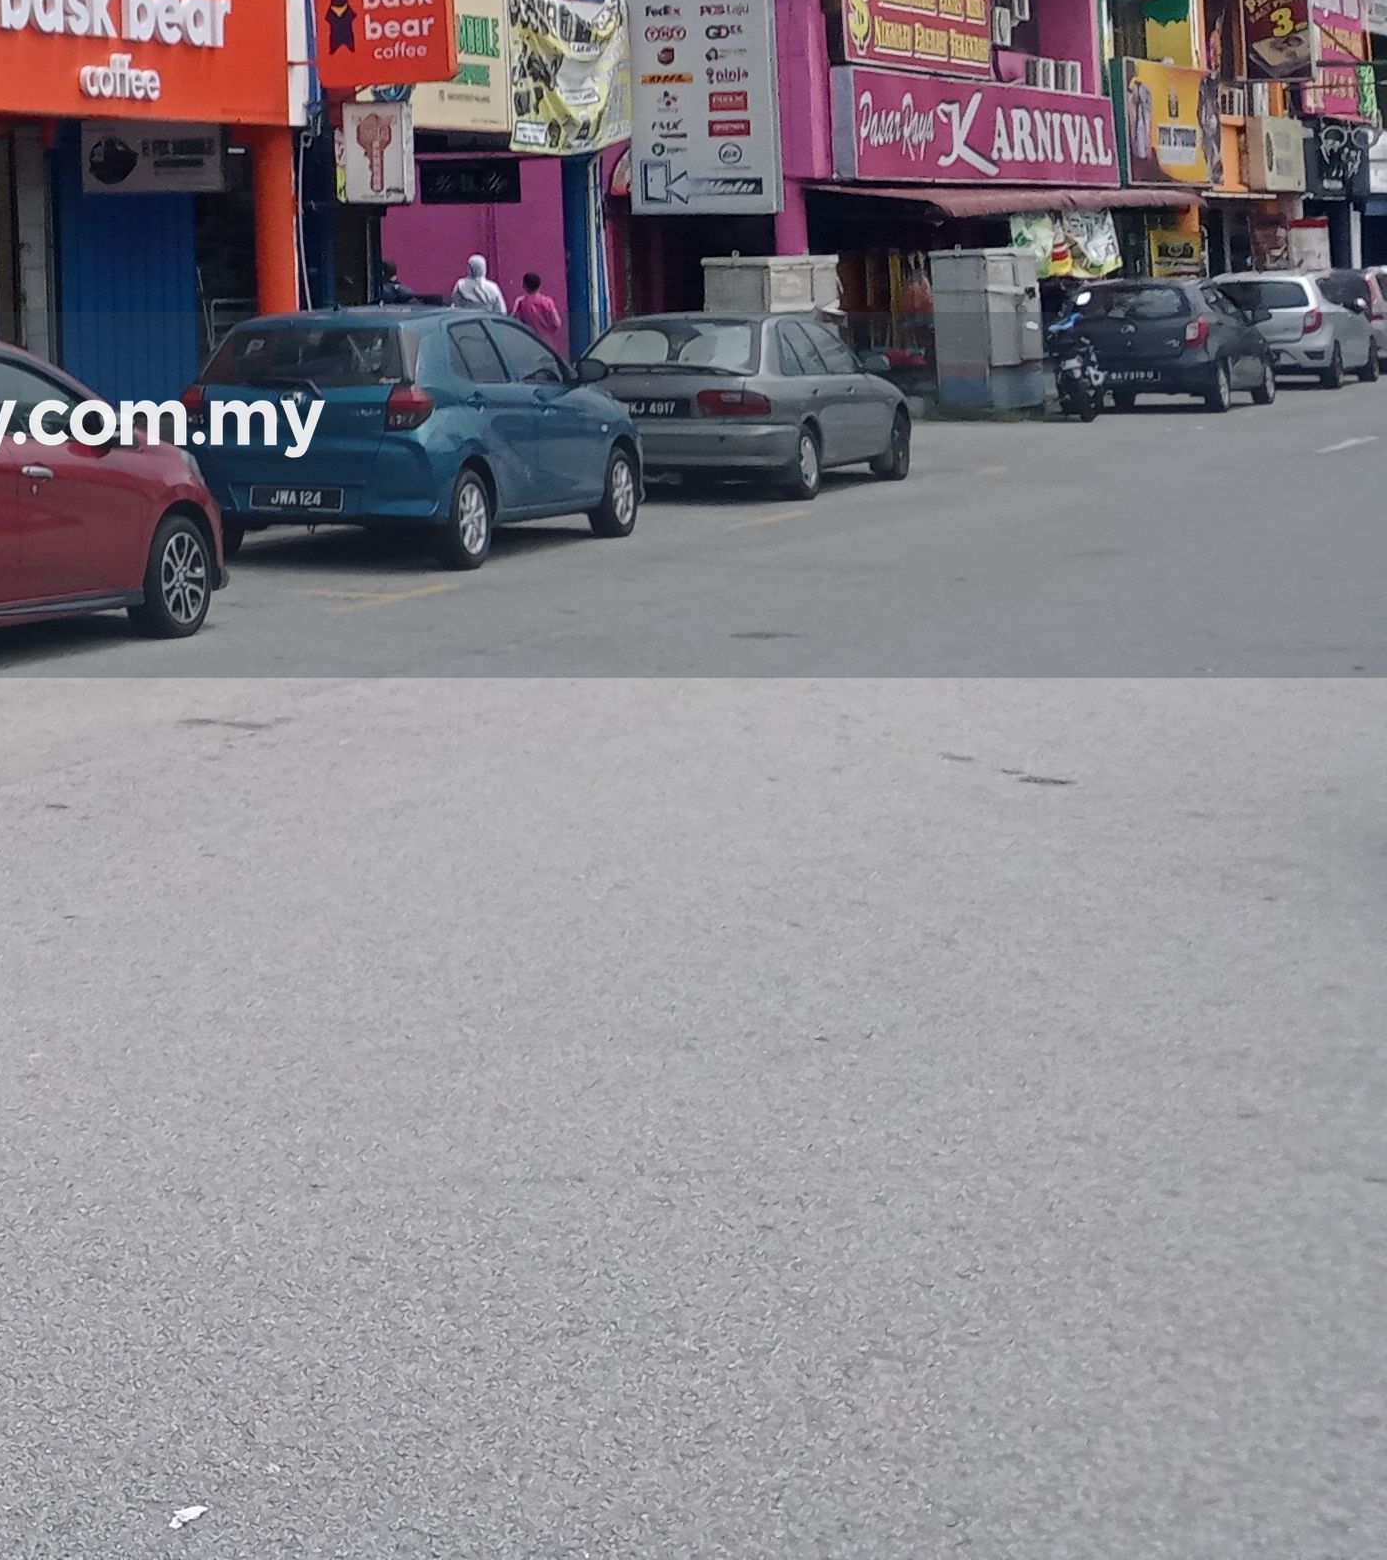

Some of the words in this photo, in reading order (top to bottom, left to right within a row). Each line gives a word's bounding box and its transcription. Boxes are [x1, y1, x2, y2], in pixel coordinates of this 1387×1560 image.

[363, 16, 435, 41] bear
[373, 41, 428, 60] coffee
[79, 52, 162, 102] coffee
[858, 90, 901, 157] Pasar
[901, 92, 935, 161] Raya
[937, 91, 1113, 177] KARNIVAL
[270, 489, 299, 507] JWA
[300, 488, 322, 507] 124
